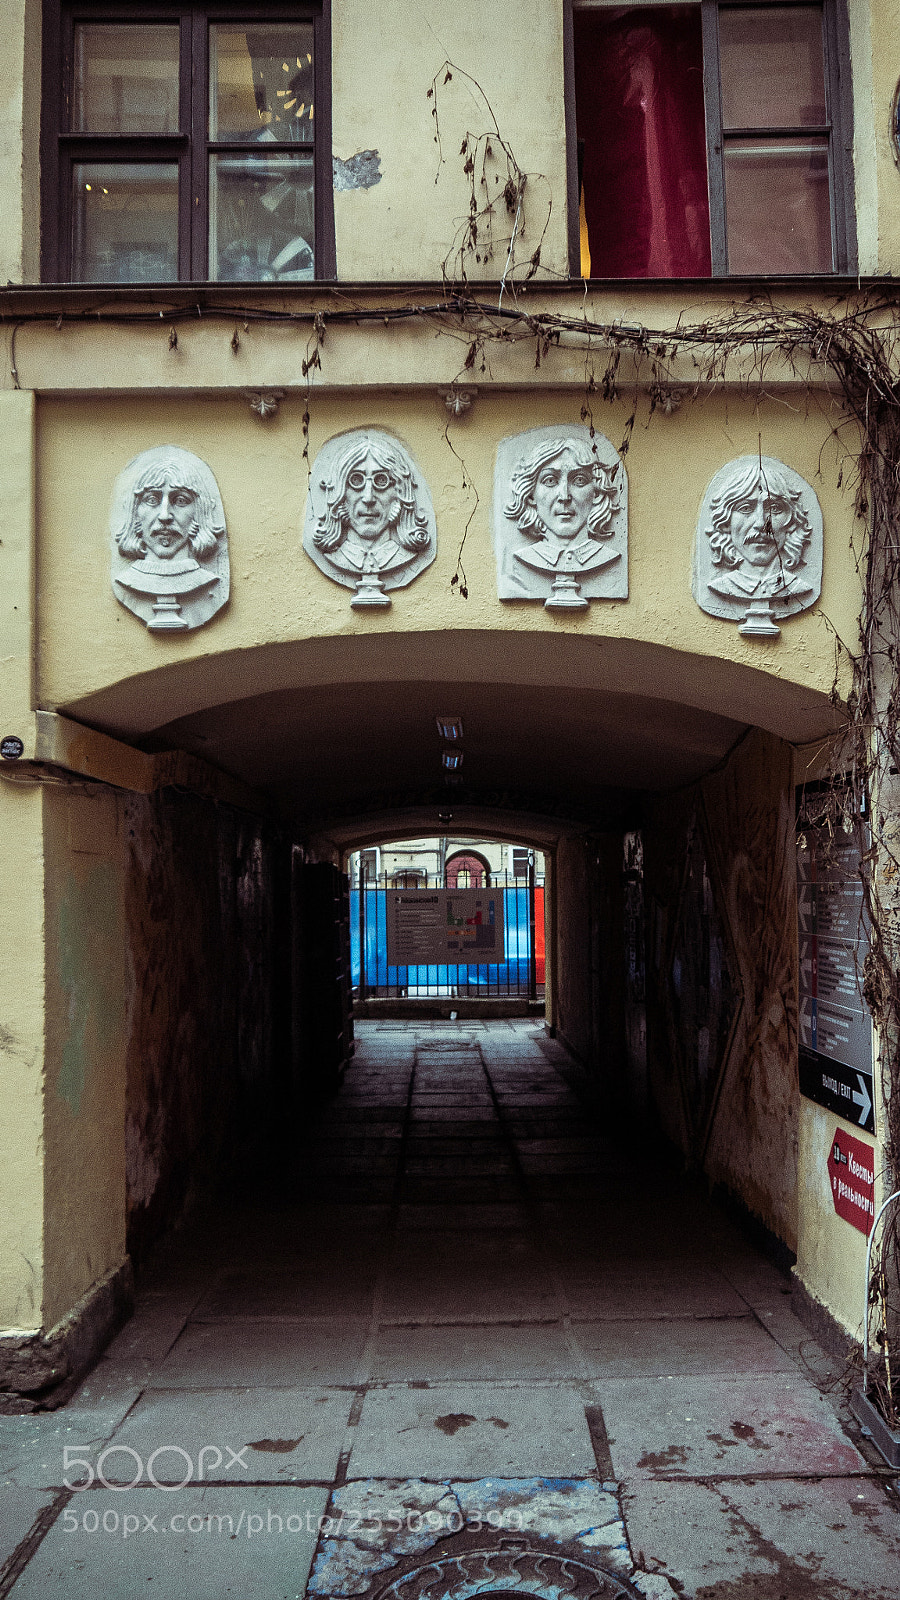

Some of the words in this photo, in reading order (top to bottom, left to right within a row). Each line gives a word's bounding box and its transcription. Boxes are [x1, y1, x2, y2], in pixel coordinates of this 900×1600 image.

[841, 1083, 851, 1100] EXIT
[848, 1150, 874, 1185] Квесты
[837, 1177, 874, 1217] реальности
